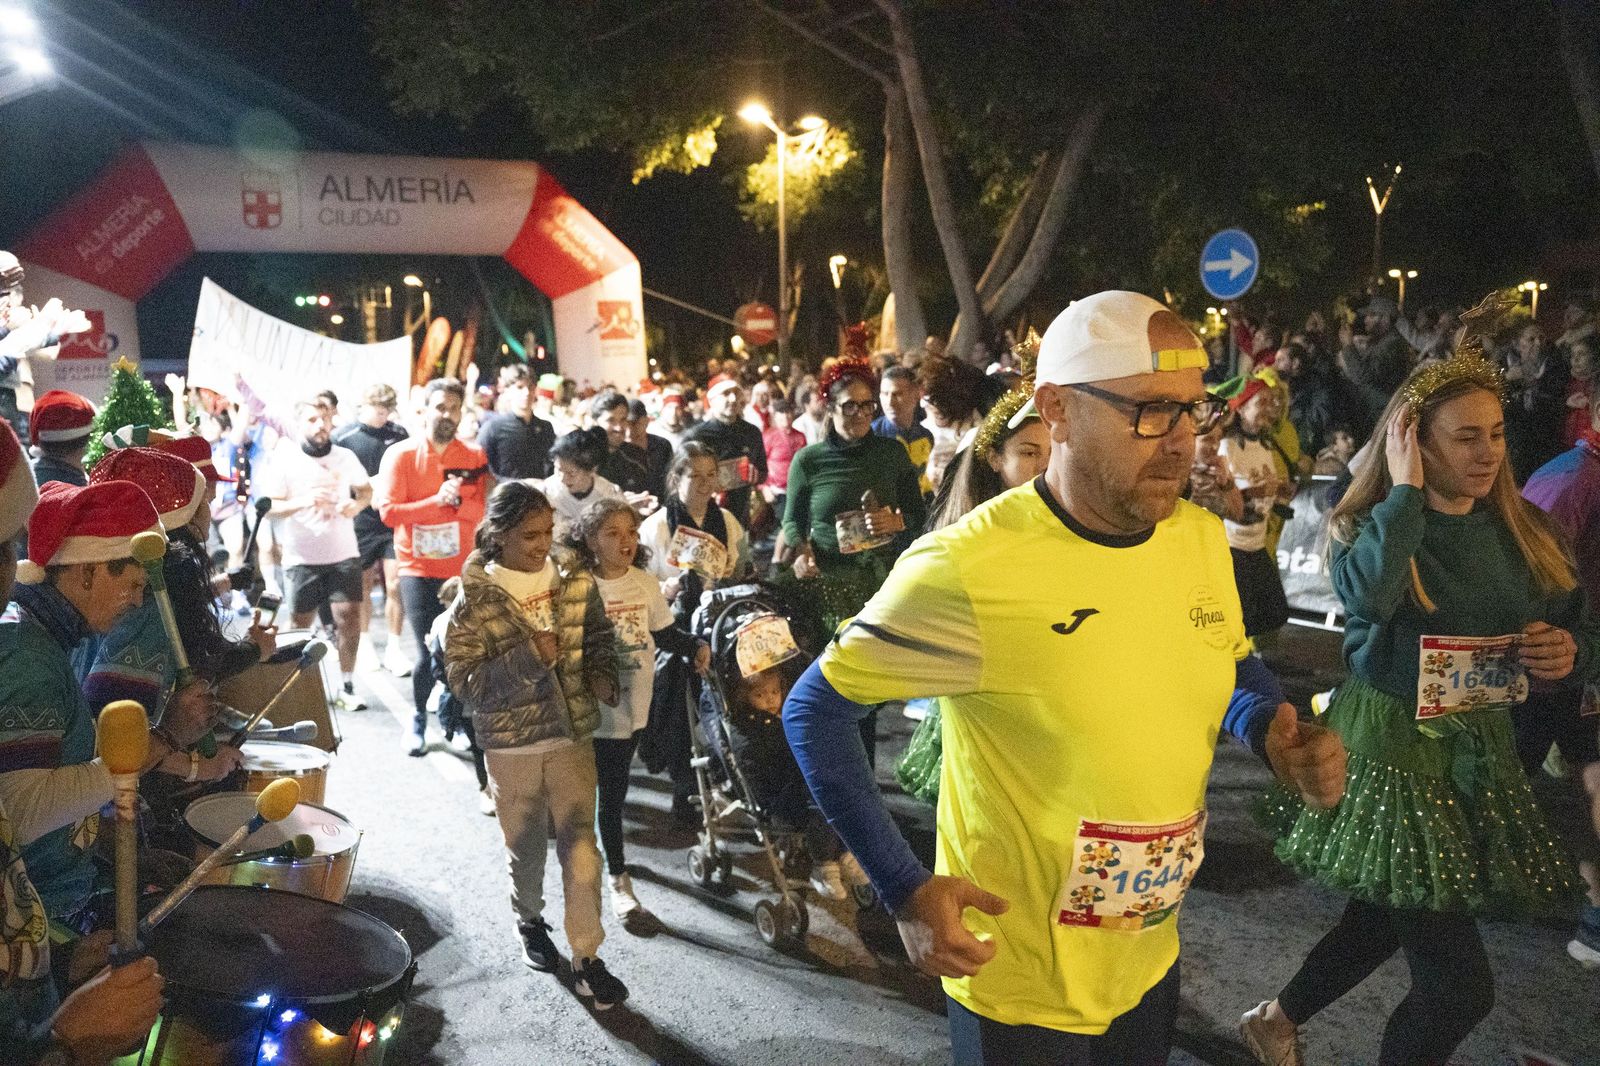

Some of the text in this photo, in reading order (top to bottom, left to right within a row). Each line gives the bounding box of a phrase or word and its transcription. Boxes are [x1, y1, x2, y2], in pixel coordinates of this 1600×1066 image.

[320, 172, 476, 204] ALMERÍA
[318, 207, 400, 226] CIUDAD
[111, 208, 165, 259] deporte
[1449, 670, 1508, 689] 1646
[1112, 860, 1184, 894] 1644
